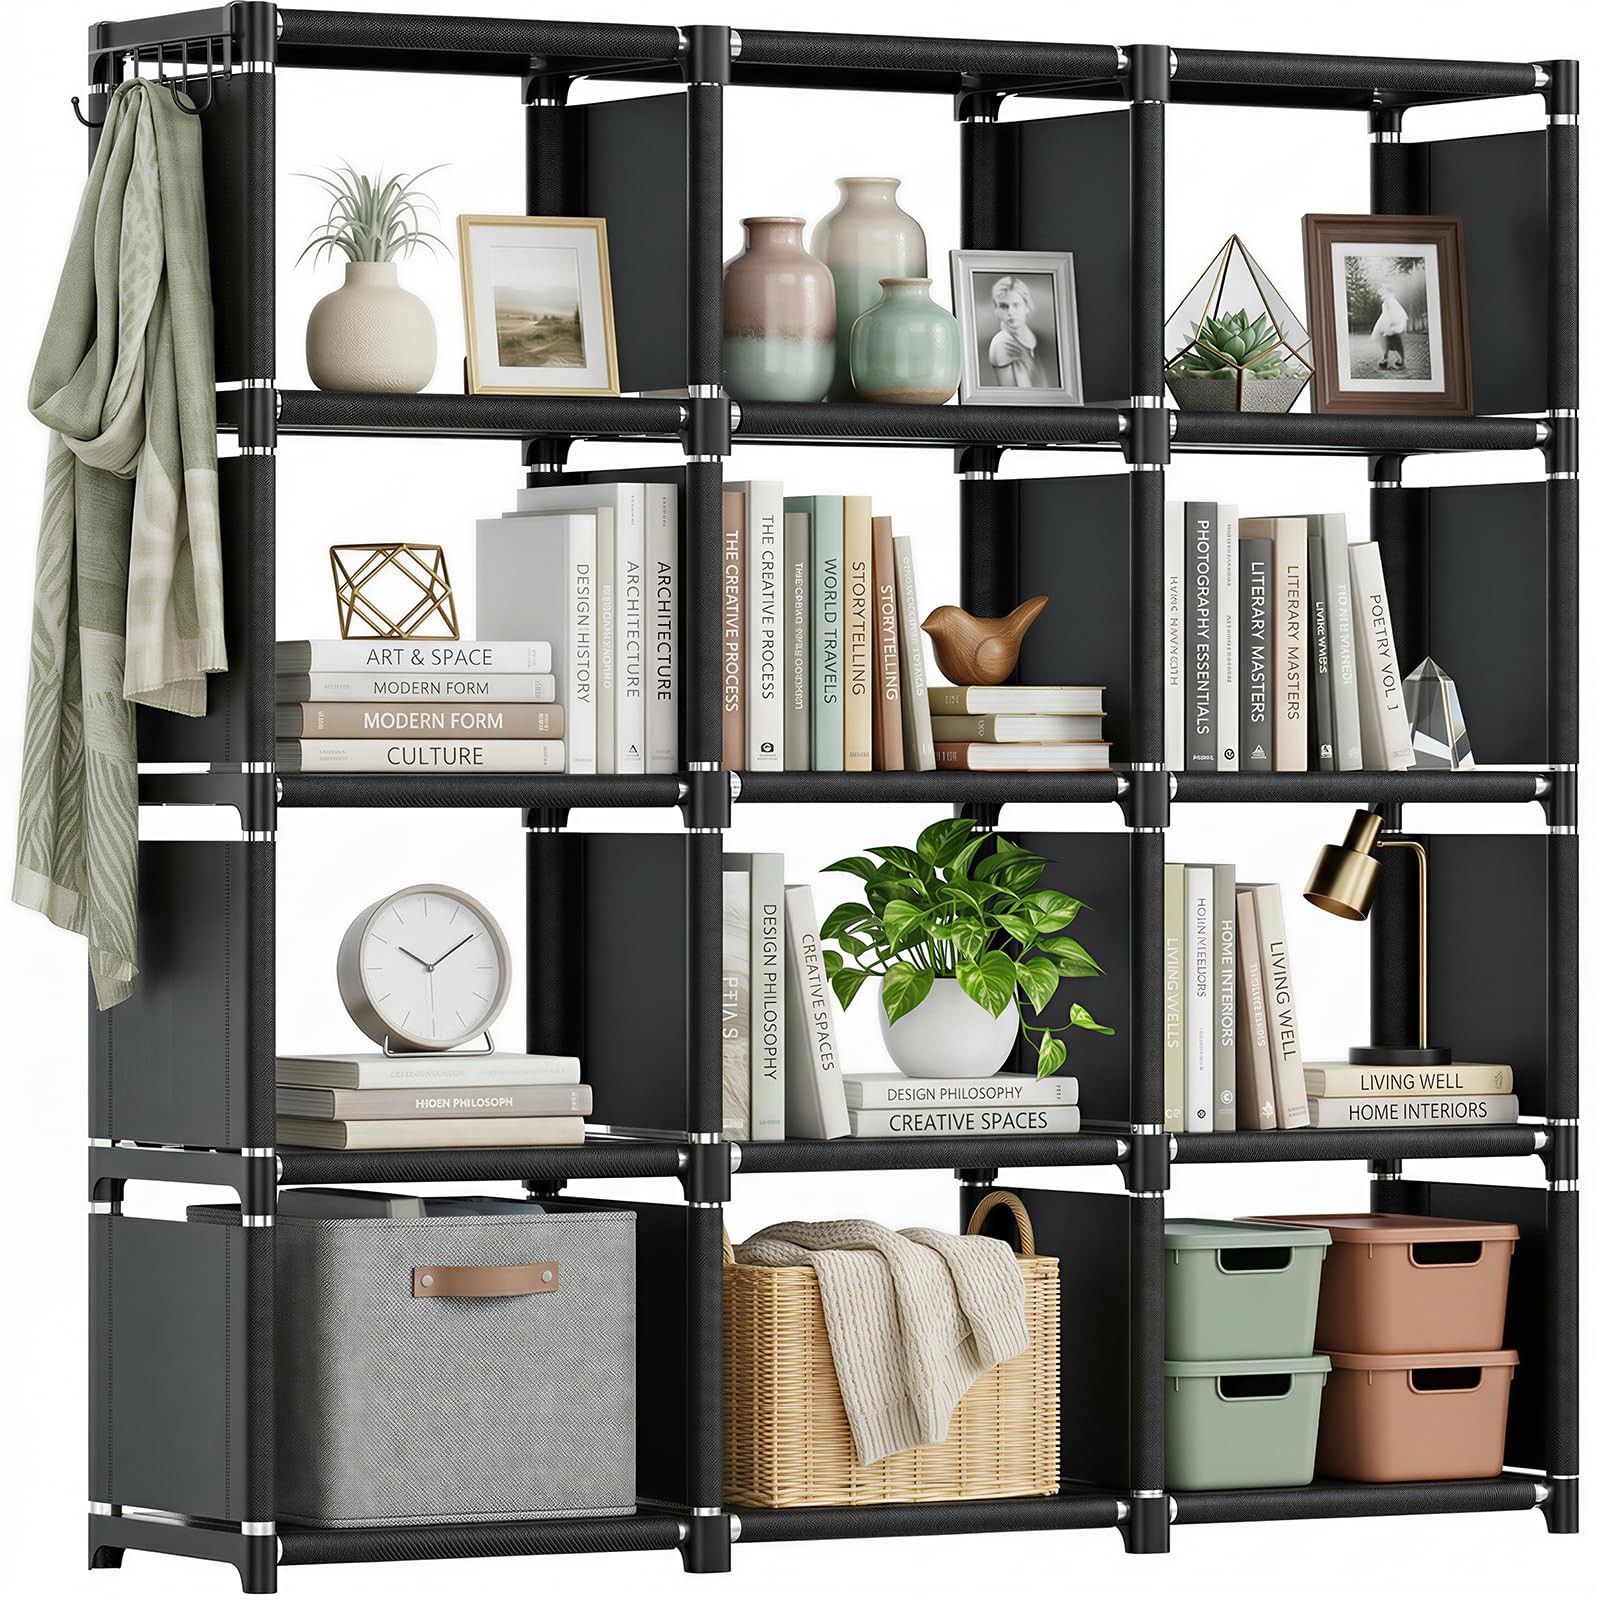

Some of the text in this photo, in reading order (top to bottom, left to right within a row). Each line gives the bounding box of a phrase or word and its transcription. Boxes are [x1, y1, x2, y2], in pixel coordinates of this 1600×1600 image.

[366, 648, 493, 666] ART & SPACE
[577, 564, 590, 703] DESIGN HISTORY
[626, 561, 640, 698] ARCHITECTURE
[657, 562, 671, 701] ARCHITECTURE
[725, 530, 739, 713] THE CREATIVE PROCESS
[761, 515, 775, 700] THE CREATIVE PROCESS
[824, 558, 837, 704] WORLD TRAVELS
[852, 561, 865, 696] STORYTELLING
[880, 585, 898, 700] STORYTELLING
[1197, 520, 1209, 735] PHOTOGRAPHY ESSENTIALS
[1251, 562, 1264, 722] LITERARY MASTERS
[1287, 566, 1299, 720] LITERARY MASTERS
[1370, 594, 1391, 657] POETRY
[1381, 663, 1397, 698] VOL
[364, 713, 503, 729] MODERN FORM
[373, 681, 489, 695] MODERN FORM
[386, 747, 484, 766] CULTURE
[764, 905, 777, 1080] DESIGN PHILOSOPHY
[802, 934, 834, 1071] CREATIVE SPACES
[1222, 920, 1233, 1046] HOME INTERIORS
[1270, 941, 1297, 1061] LIVING WELL
[453, 1097, 513, 1108] PHILOSOPH
[887, 1087, 1023, 1101] DESIGN PHILOSOPHY
[889, 1112, 1048, 1132] CREATIVE SPACES
[1349, 1102, 1487, 1121] HOME INTERIORS
[1361, 1073, 1464, 1091] LIVING WELL
